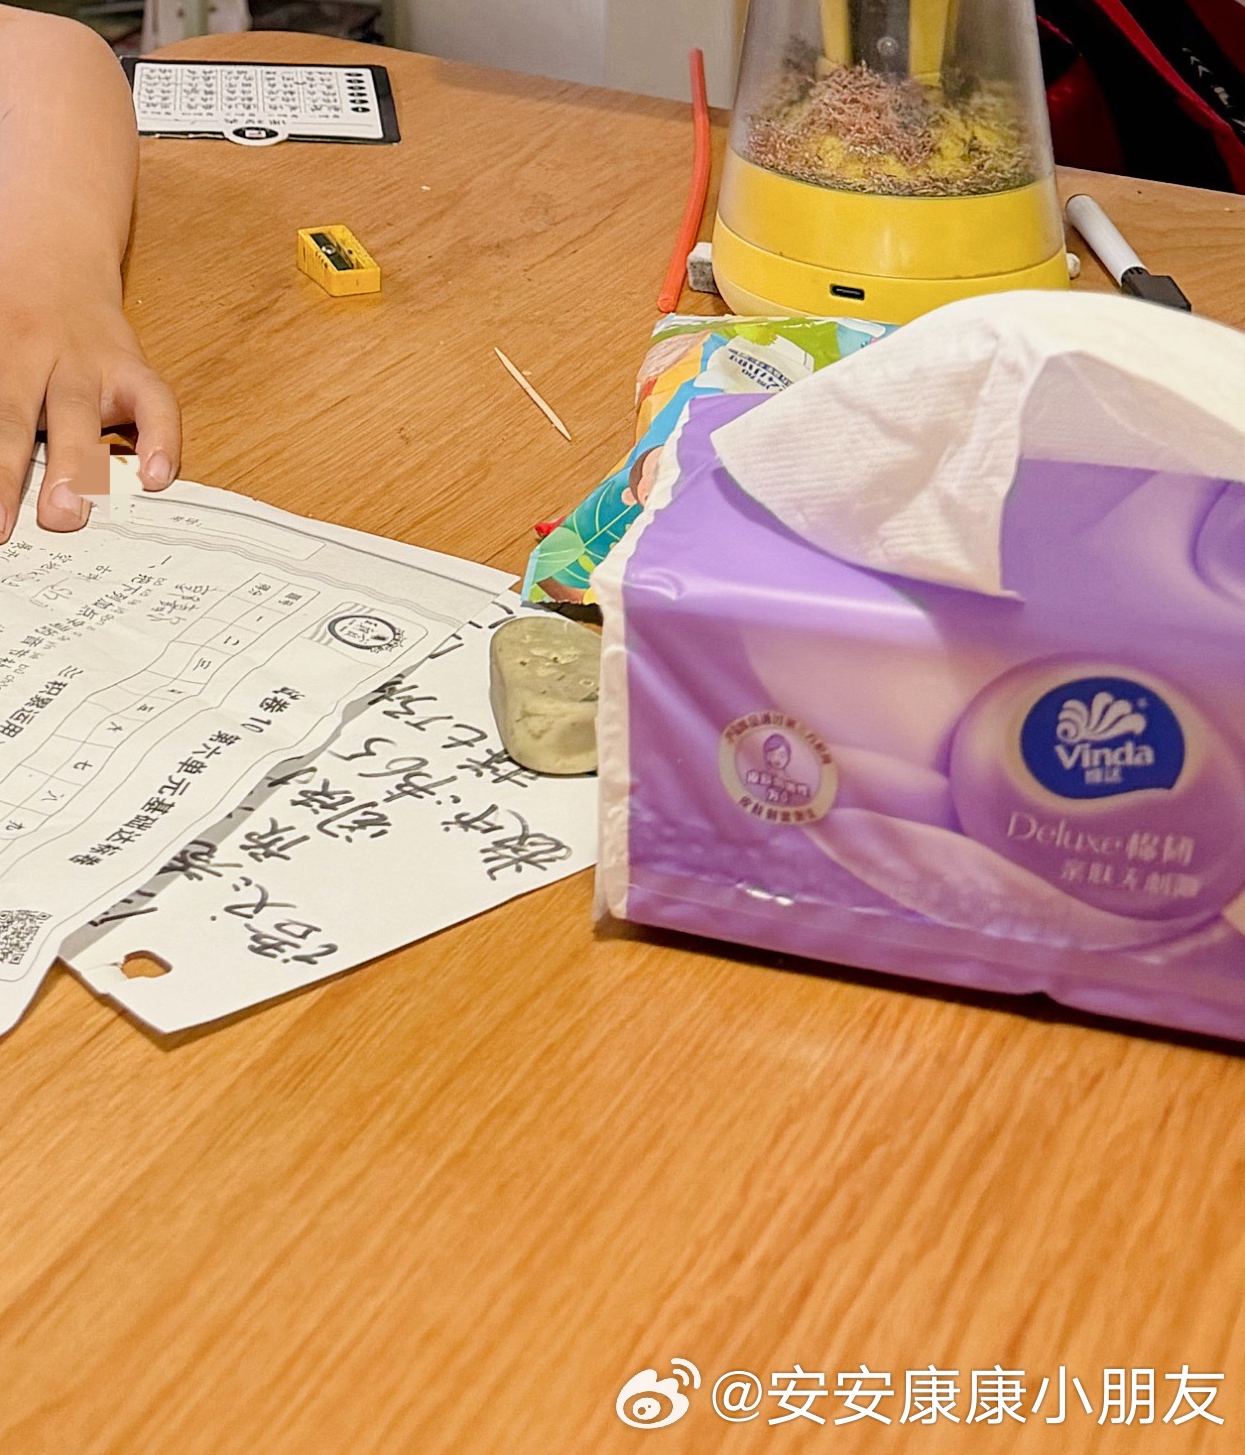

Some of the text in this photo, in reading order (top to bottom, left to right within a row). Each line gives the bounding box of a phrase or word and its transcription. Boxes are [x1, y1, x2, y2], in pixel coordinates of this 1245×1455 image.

[1054, 741, 1155, 770] Vinda
[66, 728, 240, 869] 第六单元基础达标卷
[1007, 812, 1114, 853] Deluxe
